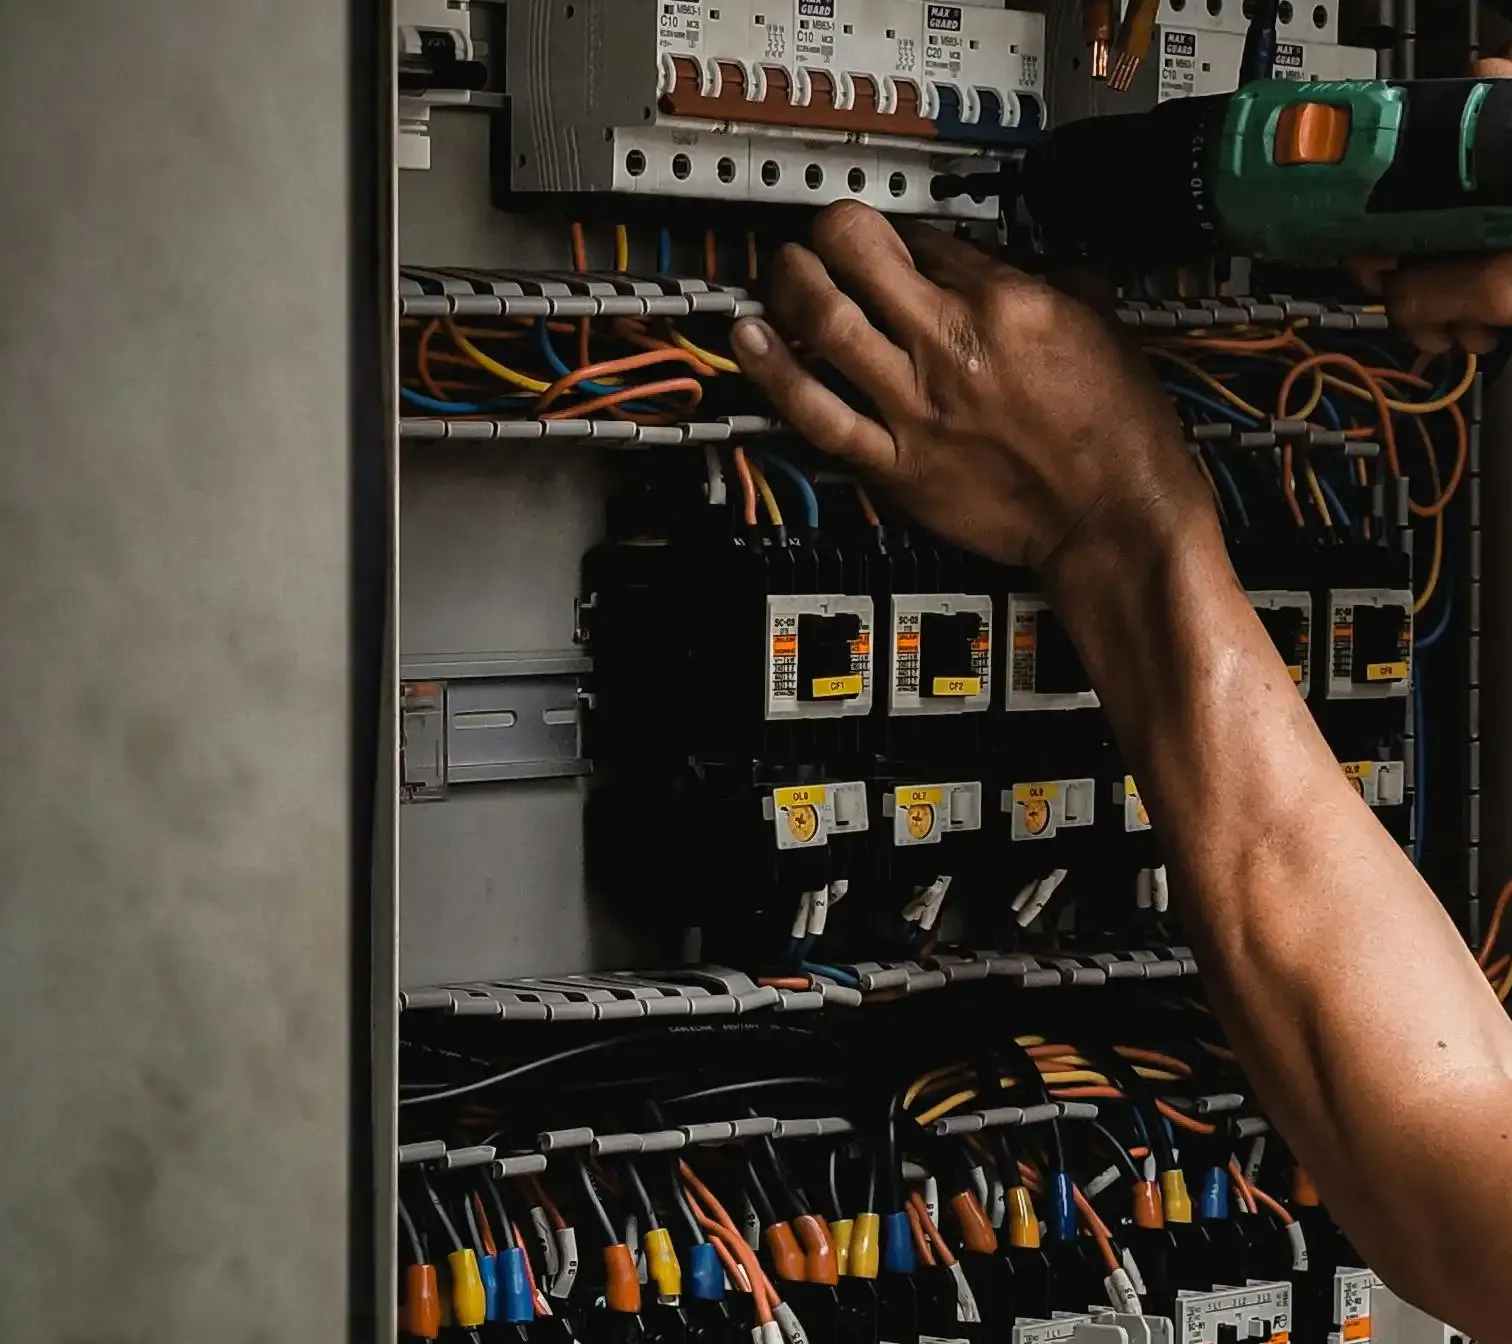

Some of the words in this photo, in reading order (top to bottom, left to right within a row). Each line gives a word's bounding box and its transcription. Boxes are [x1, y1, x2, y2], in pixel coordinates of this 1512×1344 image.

[800, 3, 831, 16] GUARD
[929, 7, 951, 18] MAX
[660, 15, 678, 28] C10
[928, 17, 959, 30] GUARD
[796, 30, 814, 44] C10
[1166, 34, 1185, 44] MAX
[1166, 43, 1193, 55] GUARD
[1276, 45, 1295, 55] MAX
[1275, 55, 1301, 65] GUARD
[1161, 68, 1177, 81] C10
[1190, 176, 1204, 197] 10
[830, 681, 845, 691] CF1
[948, 681, 965, 692] CF2
